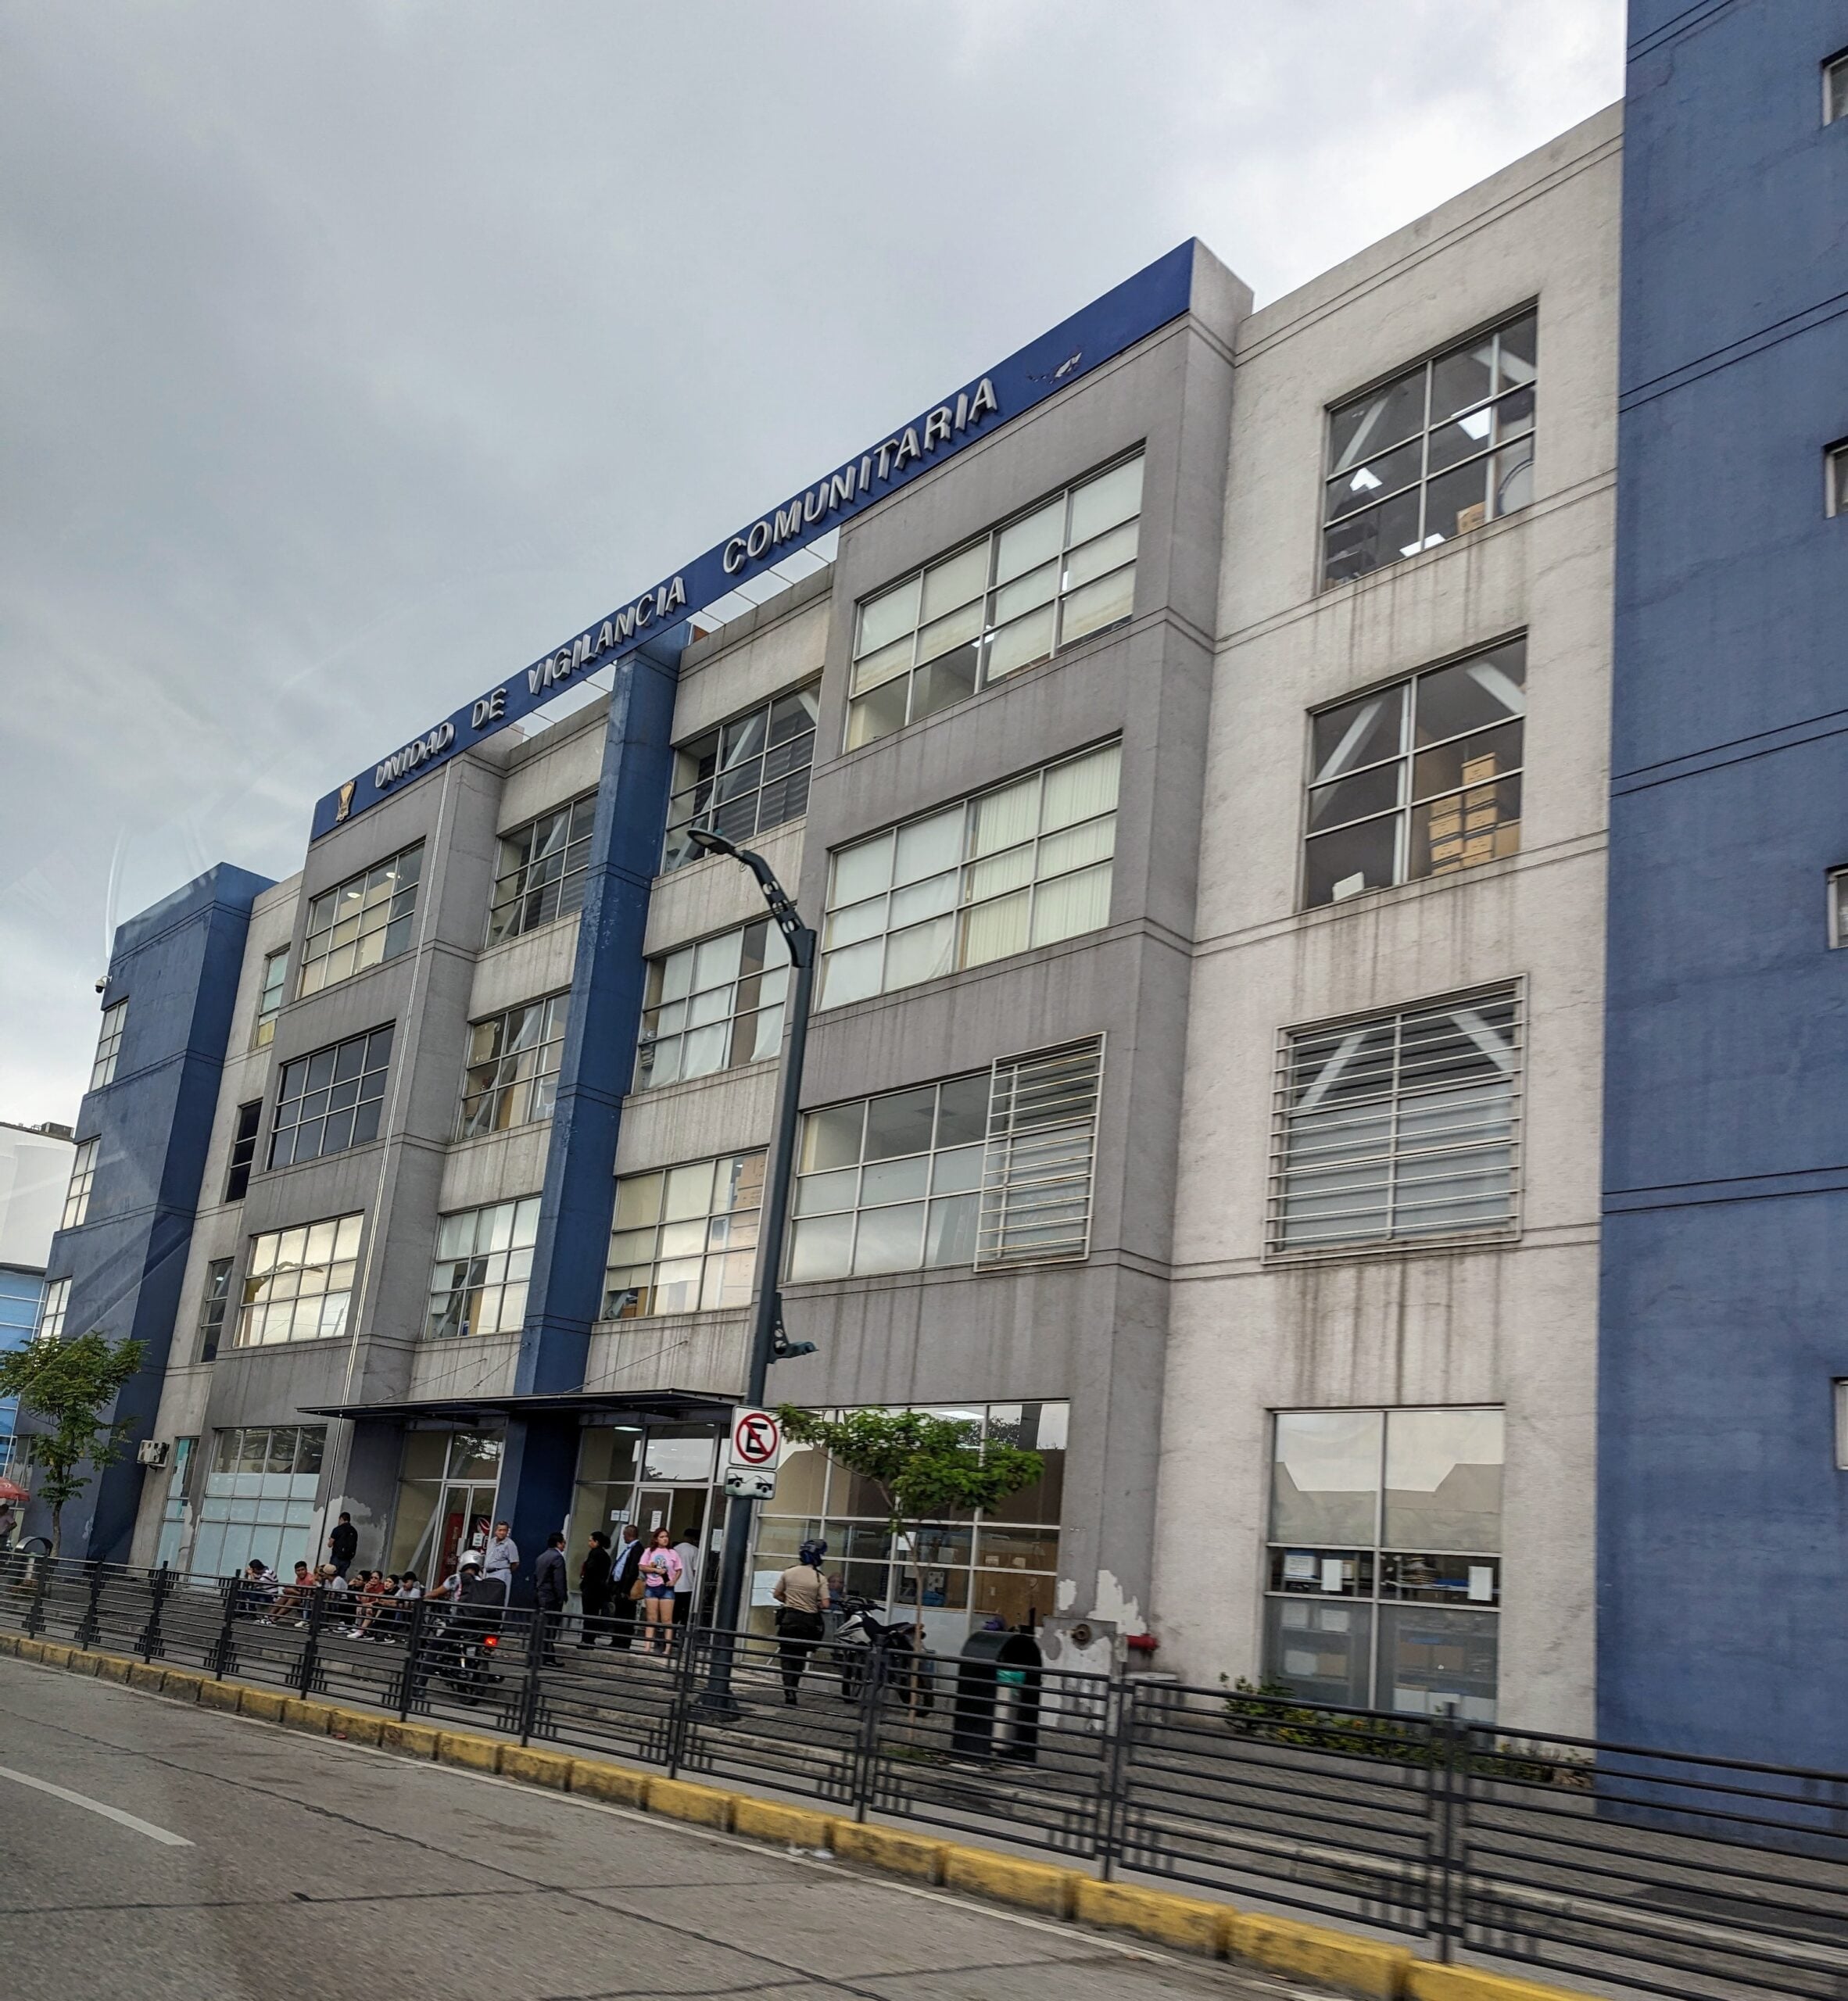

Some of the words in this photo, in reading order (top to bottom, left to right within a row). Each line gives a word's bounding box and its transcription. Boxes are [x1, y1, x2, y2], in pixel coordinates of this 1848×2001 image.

[375, 721, 456, 789] UNIDAD
[471, 687, 507, 730] DE
[528, 576, 687, 695] VIGILANCIA
[722, 378, 998, 575] COMUNITARIA
[746, 1422, 768, 1454] E
